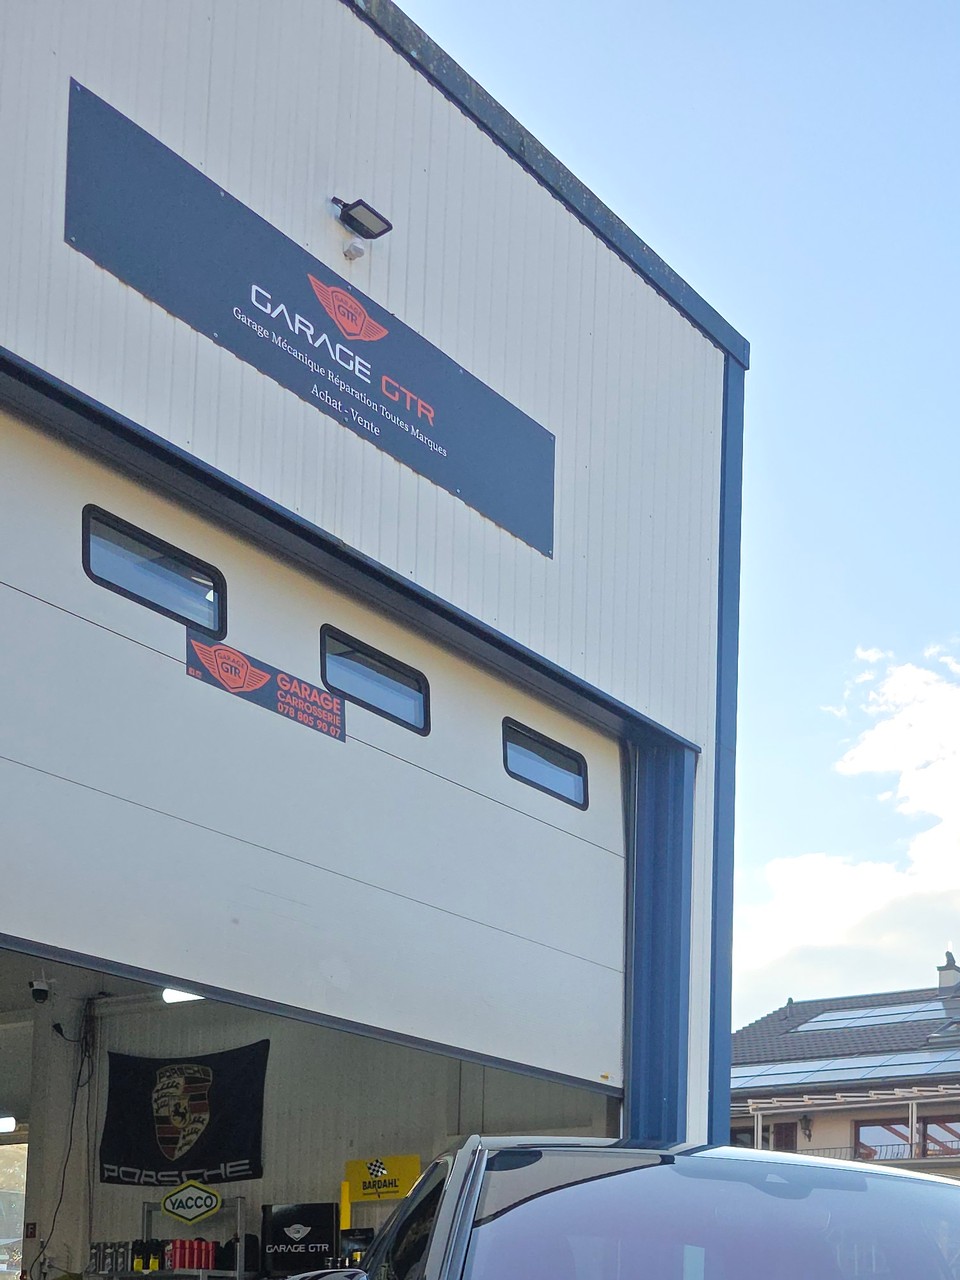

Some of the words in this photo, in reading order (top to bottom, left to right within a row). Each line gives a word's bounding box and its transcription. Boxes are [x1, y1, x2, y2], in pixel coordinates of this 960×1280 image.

[338, 304, 357, 327] GTR
[251, 284, 371, 383] GARAGE
[382, 375, 434, 426] GTR
[233, 307, 270, 338] Garage
[272, 332, 325, 376] Mécanique
[328, 370, 378, 412] Réparation
[380, 404, 409, 431] Toutes
[411, 425, 447, 457] Marques
[311, 384, 342, 412] Achat
[351, 408, 380, 436] Vente
[221, 662, 241, 679] GTR
[276, 673, 341, 714] GARAGE
[277, 690, 341, 727] CARROSSERIE
[278, 702, 295, 717] 078
[297, 711, 314, 726] 805
[317, 720, 328, 732] 90
[330, 725, 341, 738] 07
[103, 1160, 252, 1185] PORSCHE
[362, 1178, 399, 1190] BARDAHL
[169, 1195, 214, 1210] YACCO
[266, 1244, 306, 1253] GARAGE
[309, 1243, 330, 1252] GTR
